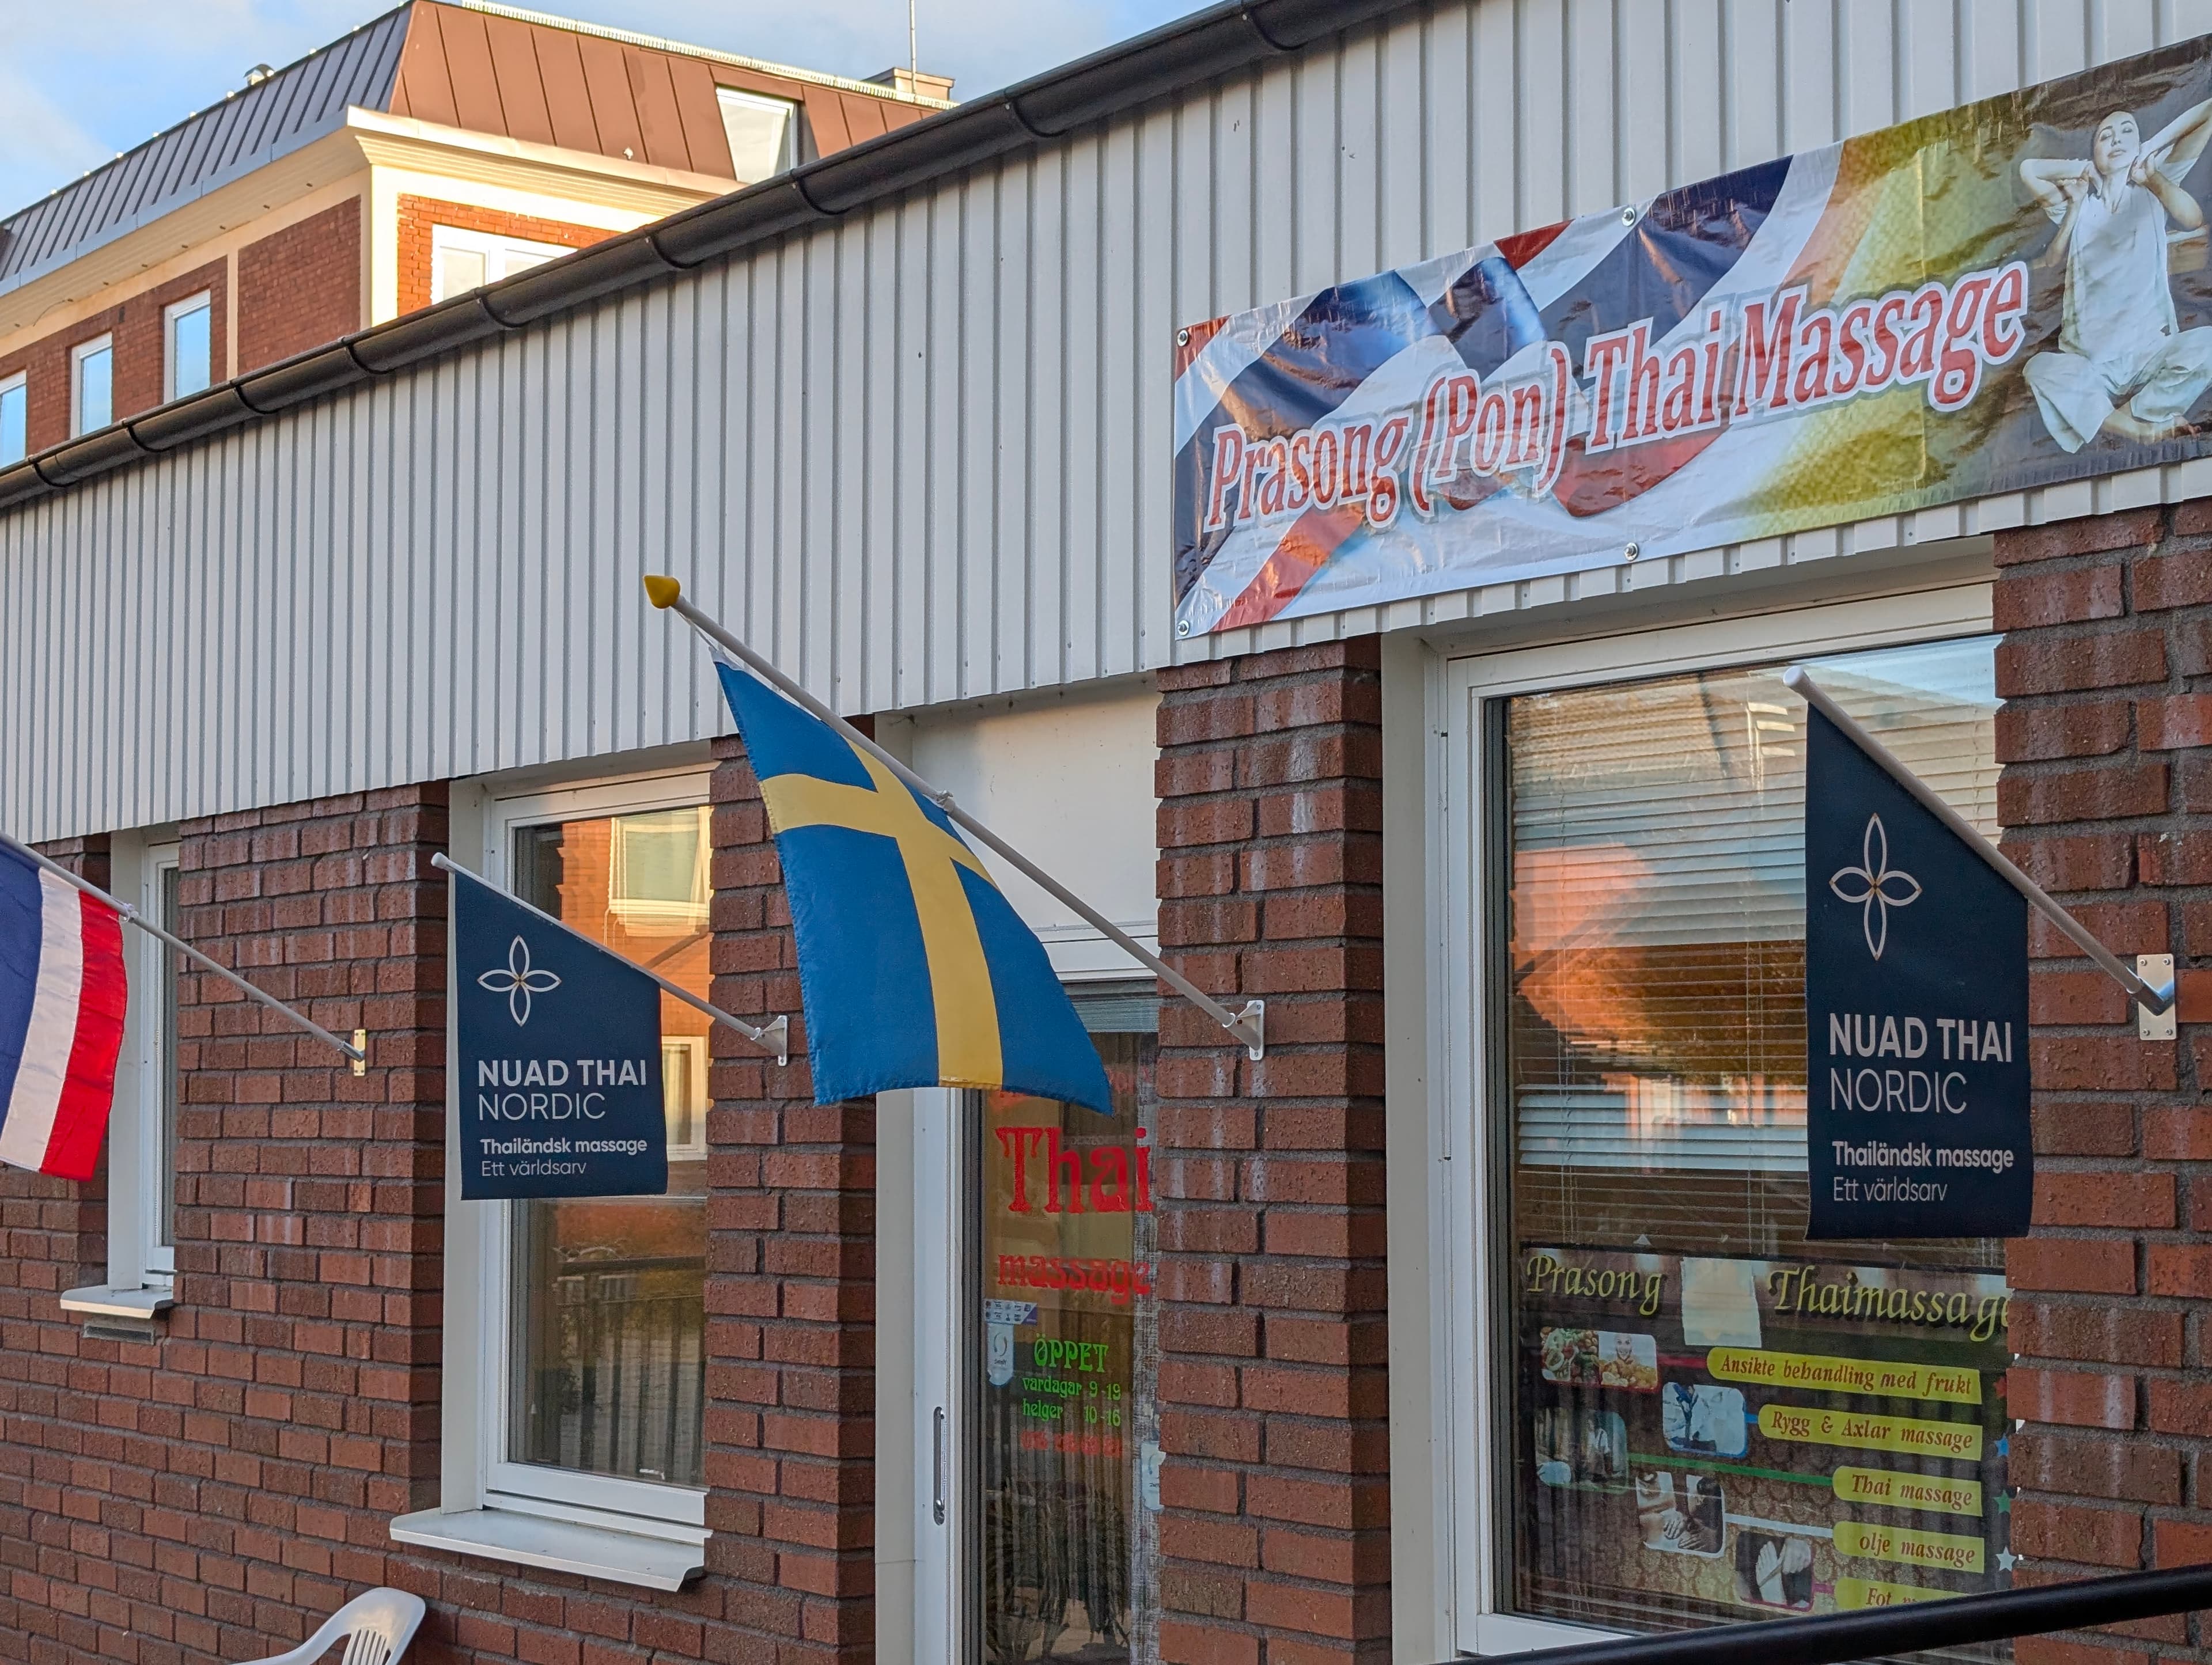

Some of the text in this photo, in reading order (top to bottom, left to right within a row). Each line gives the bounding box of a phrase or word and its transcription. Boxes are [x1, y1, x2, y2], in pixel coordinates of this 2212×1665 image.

[1208, 267, 2024, 524] Prasong (Pon) Thai Massage
[1830, 1012, 2012, 1063] NUAD THAI
[478, 1059, 647, 1087] NUAD THAI
[1830, 1068, 1967, 1114] NORDIC
[479, 1092, 606, 1121] NORDIC
[480, 1137, 647, 1156] Thailändsk massage
[1832, 1140, 2014, 1174] Thailändsk massage
[481, 1158, 587, 1177] Ett världsarv
[995, 1127, 1156, 1214] Thai
[1833, 1176, 1948, 1202] Ett världsarv
[997, 1254, 1151, 1305] massage
[1527, 1254, 1664, 1315] Prasong
[1033, 1333, 1109, 1373] ÖPPET
[1022, 1375, 1082, 1398] vardagar
[1720, 1355, 1972, 1397] Ansikte behandling med frukt
[1022, 1398, 1063, 1422] helger
[1771, 1411, 1974, 1454] Rygg & Axlar massage
[1852, 1473, 1973, 1511] Thai massage
[1859, 1531, 1975, 1568] olje massage
[1866, 1587, 1892, 1606] Fot
